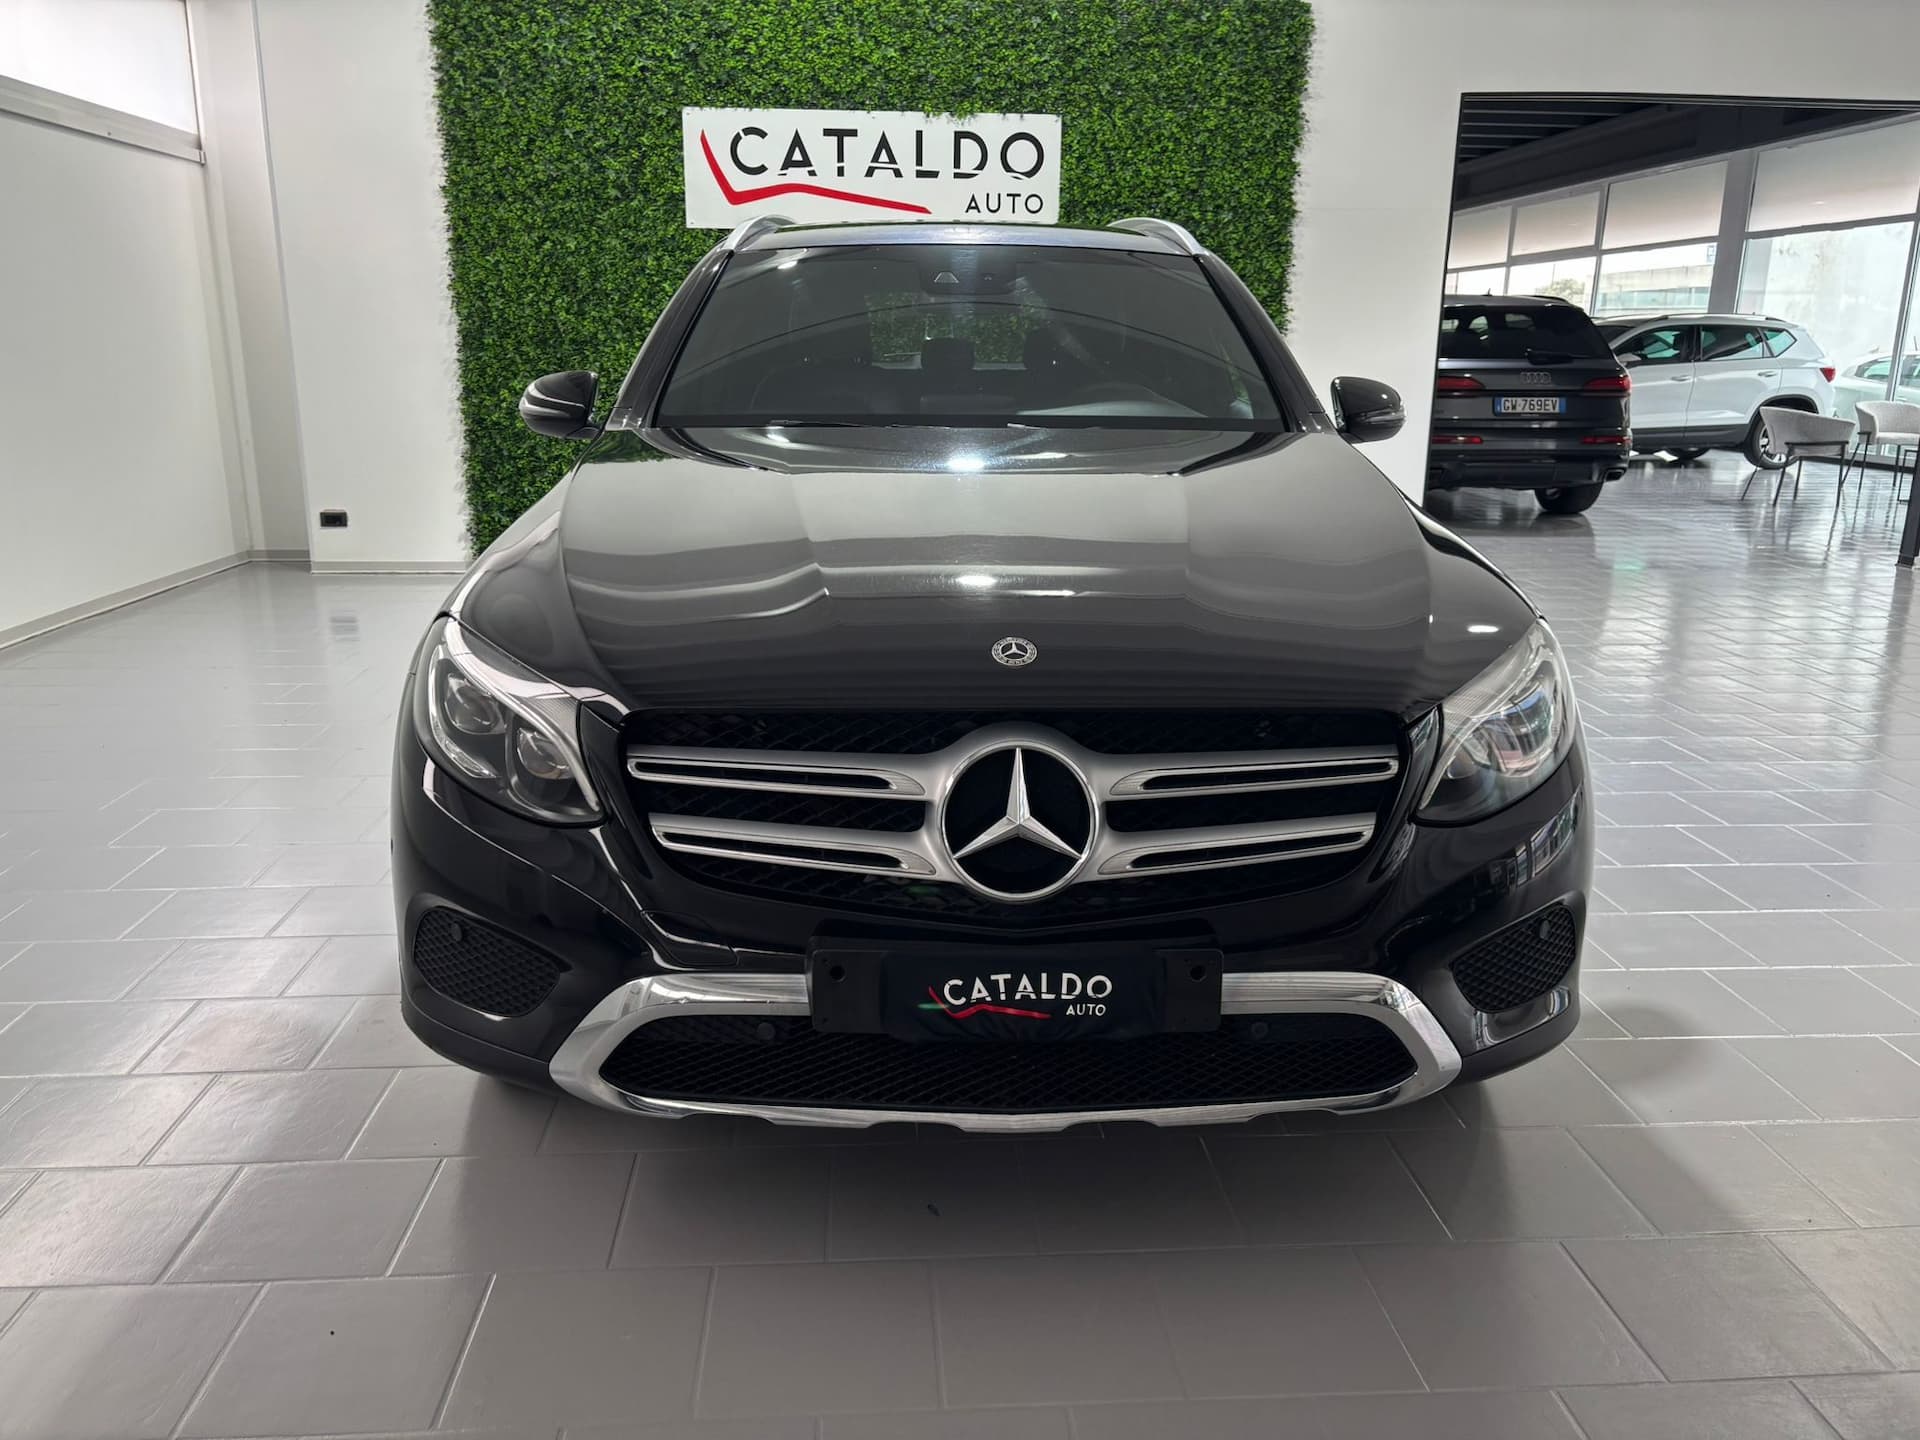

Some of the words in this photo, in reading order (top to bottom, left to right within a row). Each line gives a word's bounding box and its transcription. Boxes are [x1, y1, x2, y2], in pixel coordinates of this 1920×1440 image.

[730, 126, 1044, 180] CATALDO
[964, 193, 1044, 215] AUTO
[943, 972, 1113, 1006] CATALDO
[1065, 1004, 1107, 1016] AUTO
